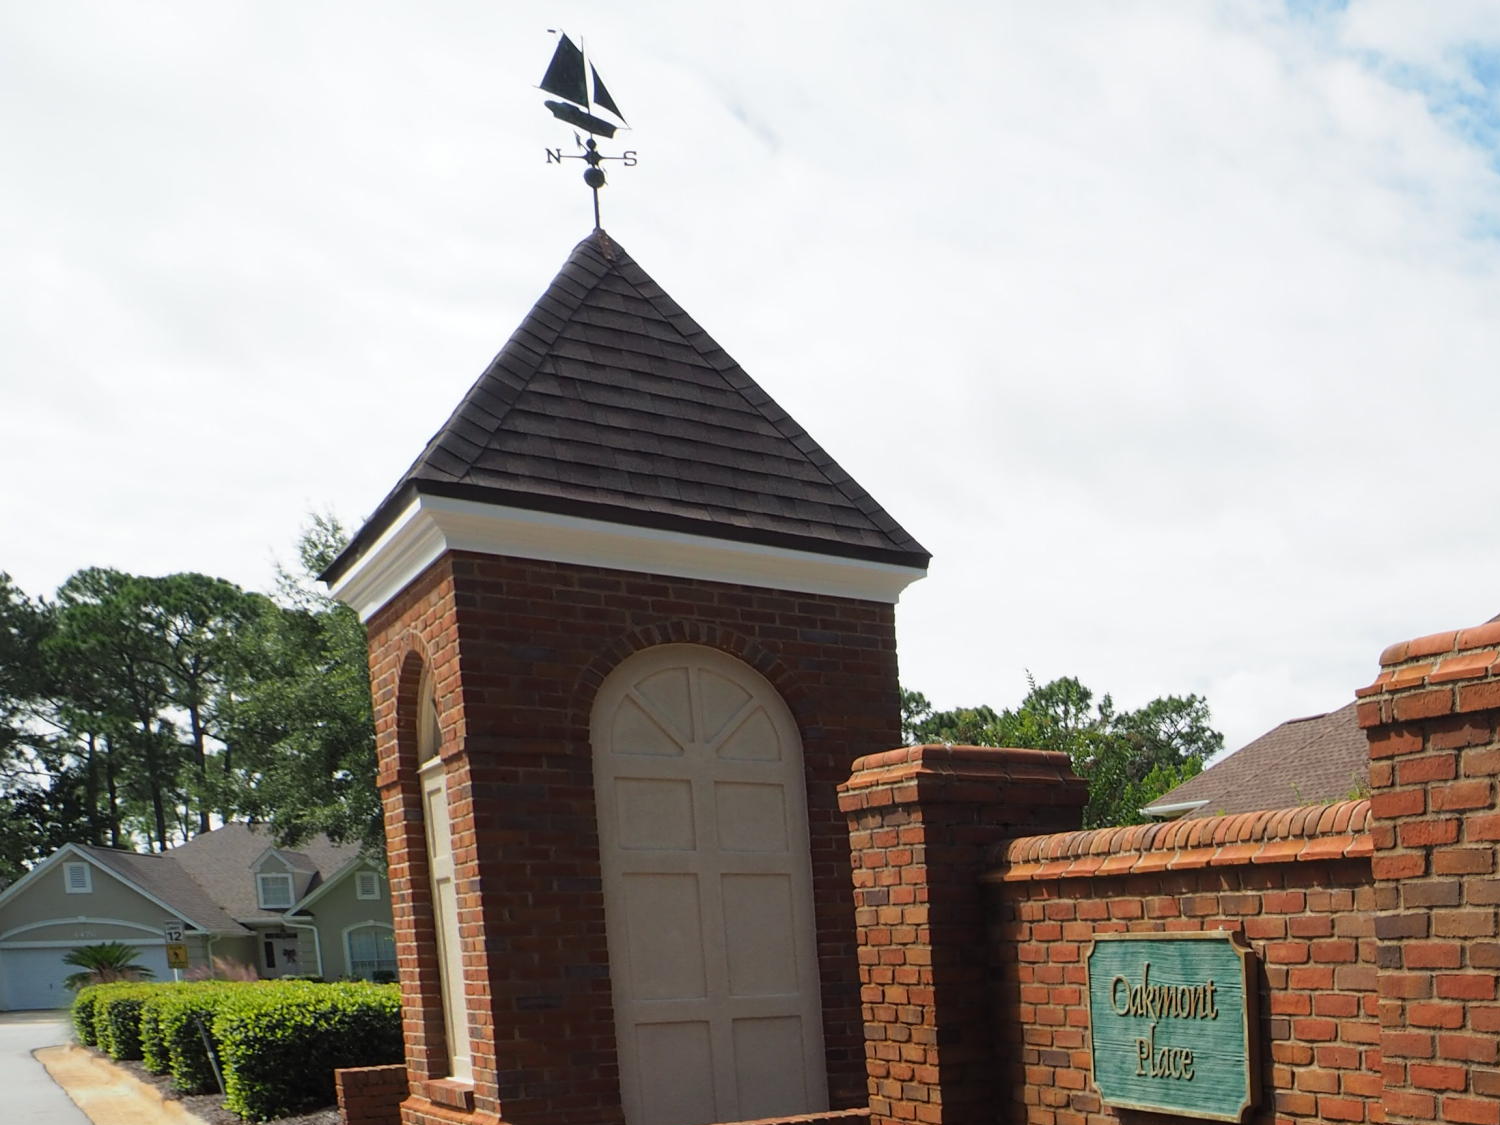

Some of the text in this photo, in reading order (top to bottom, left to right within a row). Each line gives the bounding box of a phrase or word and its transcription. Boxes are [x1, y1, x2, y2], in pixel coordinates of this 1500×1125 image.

[545, 147, 561, 163] N
[623, 150, 638, 166] S
[167, 931, 182, 941] 12
[1111, 961, 1219, 1023] Oakmont
[1135, 1023, 1195, 1080] Place
